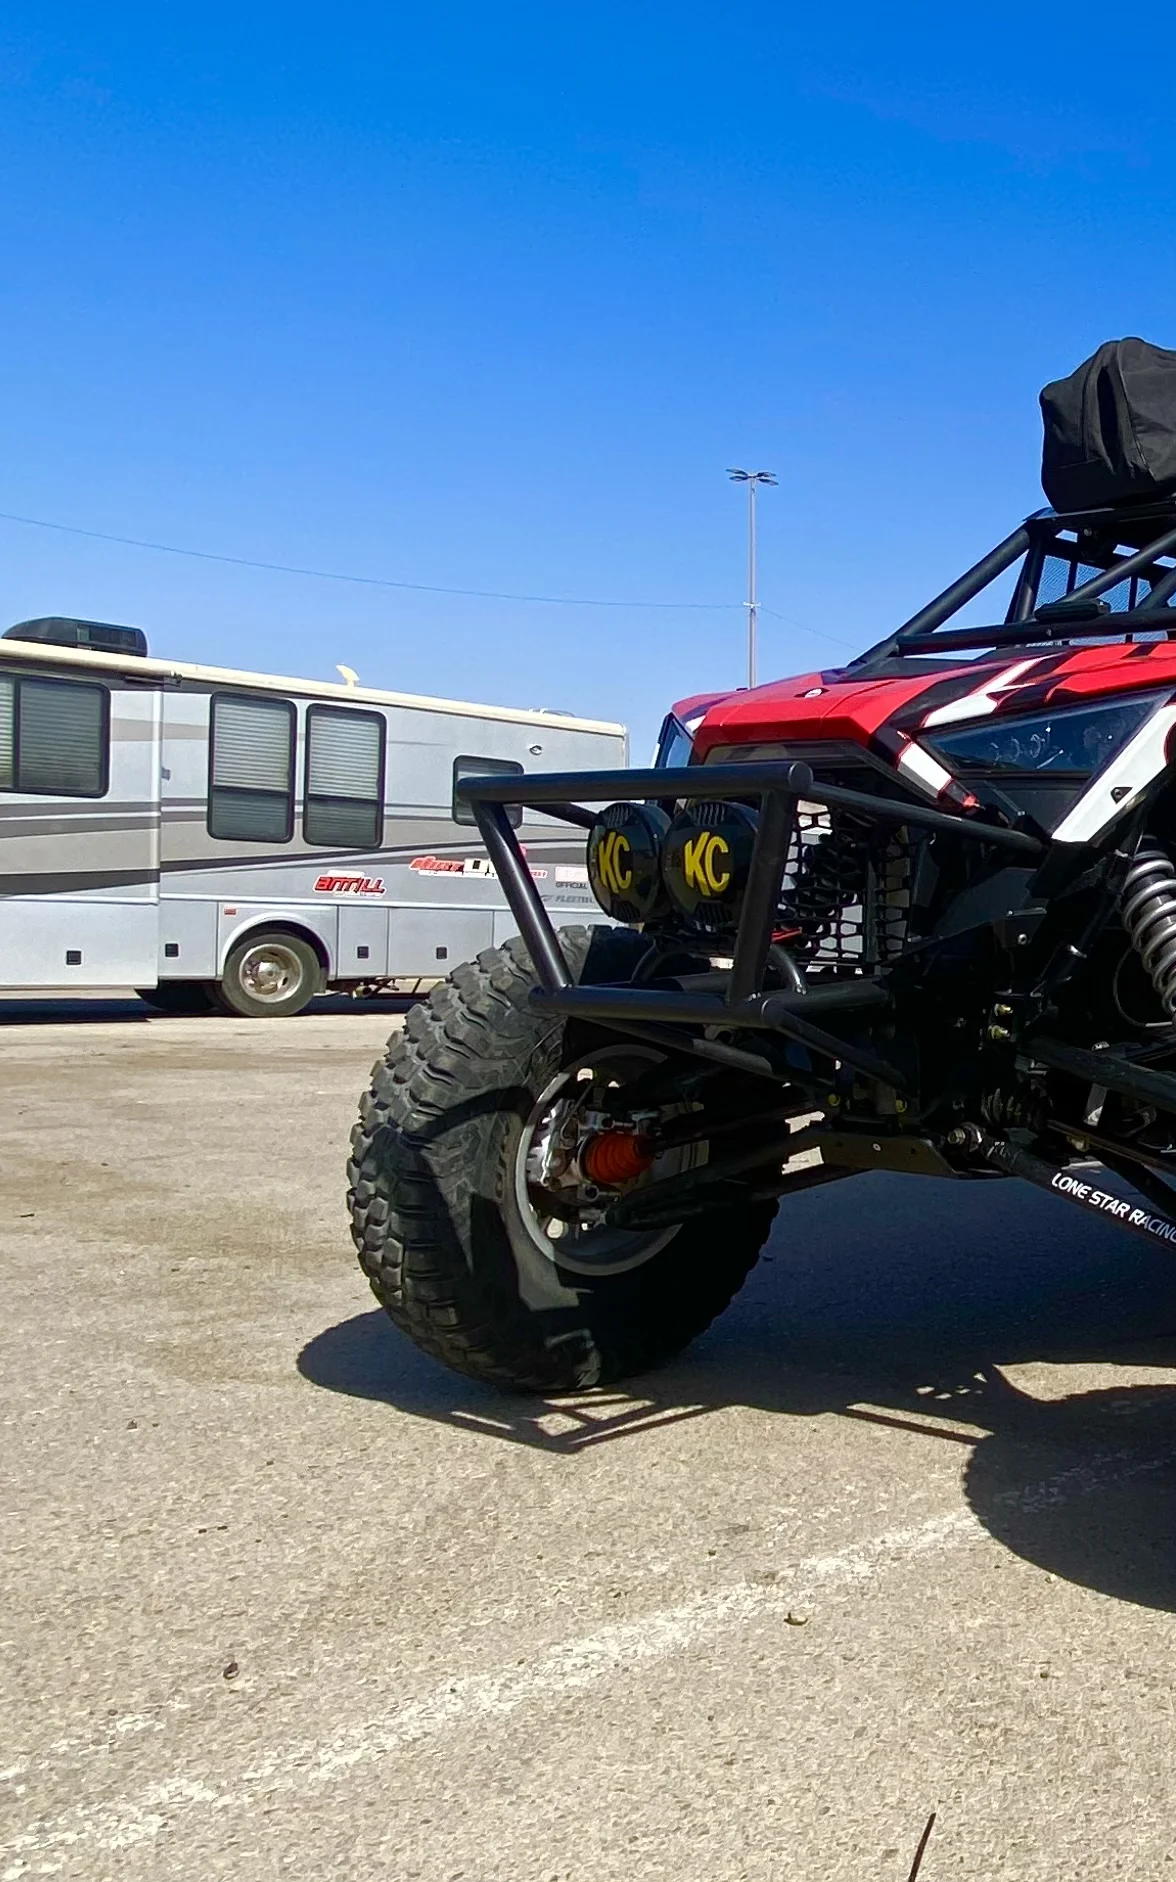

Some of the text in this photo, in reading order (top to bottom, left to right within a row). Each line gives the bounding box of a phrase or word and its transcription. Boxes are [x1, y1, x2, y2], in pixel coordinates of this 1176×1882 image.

[598, 831, 632, 894] KC
[684, 831, 730, 897] KC
[1051, 1173, 1092, 1199] LONE
[1088, 1191, 1131, 1218] STAR
